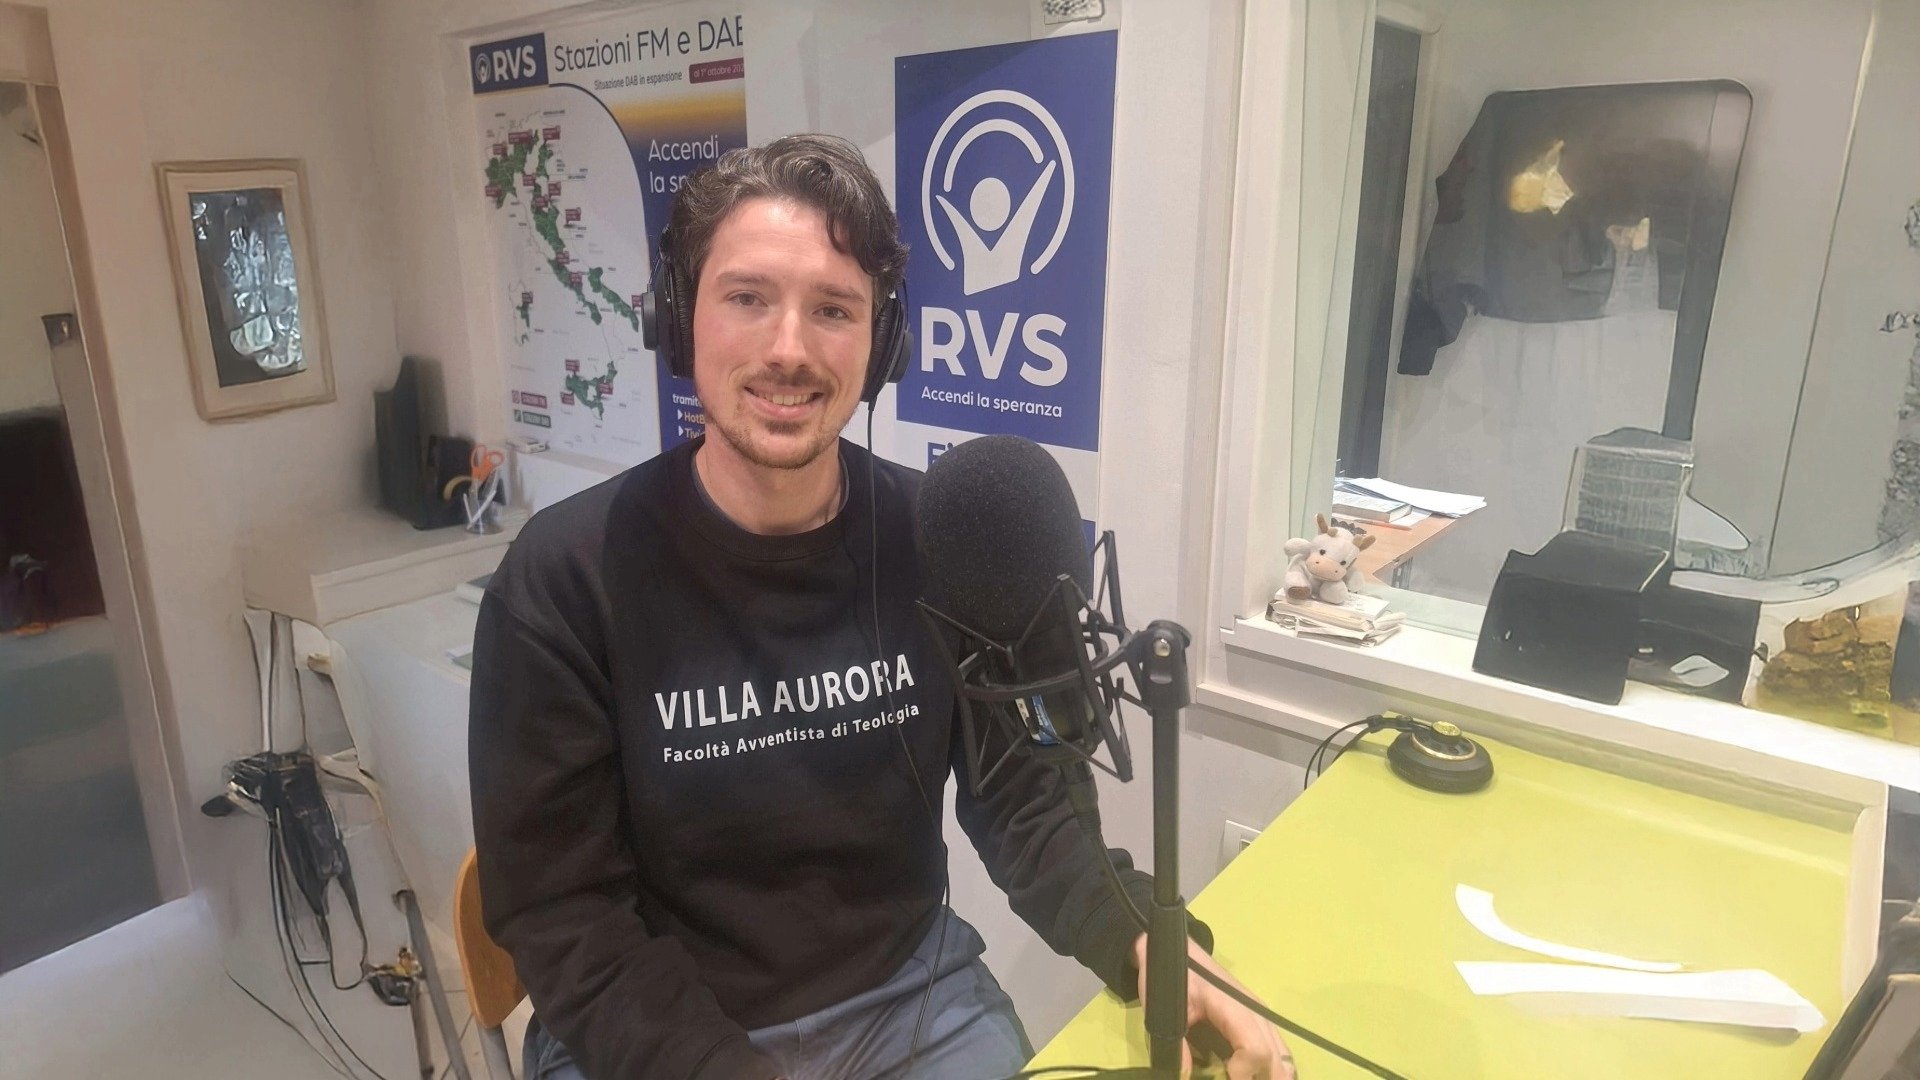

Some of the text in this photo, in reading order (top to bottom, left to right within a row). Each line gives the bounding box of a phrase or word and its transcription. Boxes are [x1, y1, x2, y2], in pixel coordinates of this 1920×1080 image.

[492, 44, 537, 82] RVS
[554, 33, 631, 72] Stazioni
[637, 27, 669, 61] FM
[677, 31, 690, 54] e
[594, 71, 683, 91] Situazione DAB in espansione
[648, 135, 719, 162] Accendi
[649, 172, 665, 193] la
[921, 306, 1068, 387] RVS
[684, 411, 705, 424] HotB
[921, 385, 1062, 418] Accendi la speranza
[654, 654, 915, 730] VILLA AURORA
[663, 740, 730, 763] Facoltà
[736, 727, 825, 755] Avventista
[831, 722, 848, 737] di
